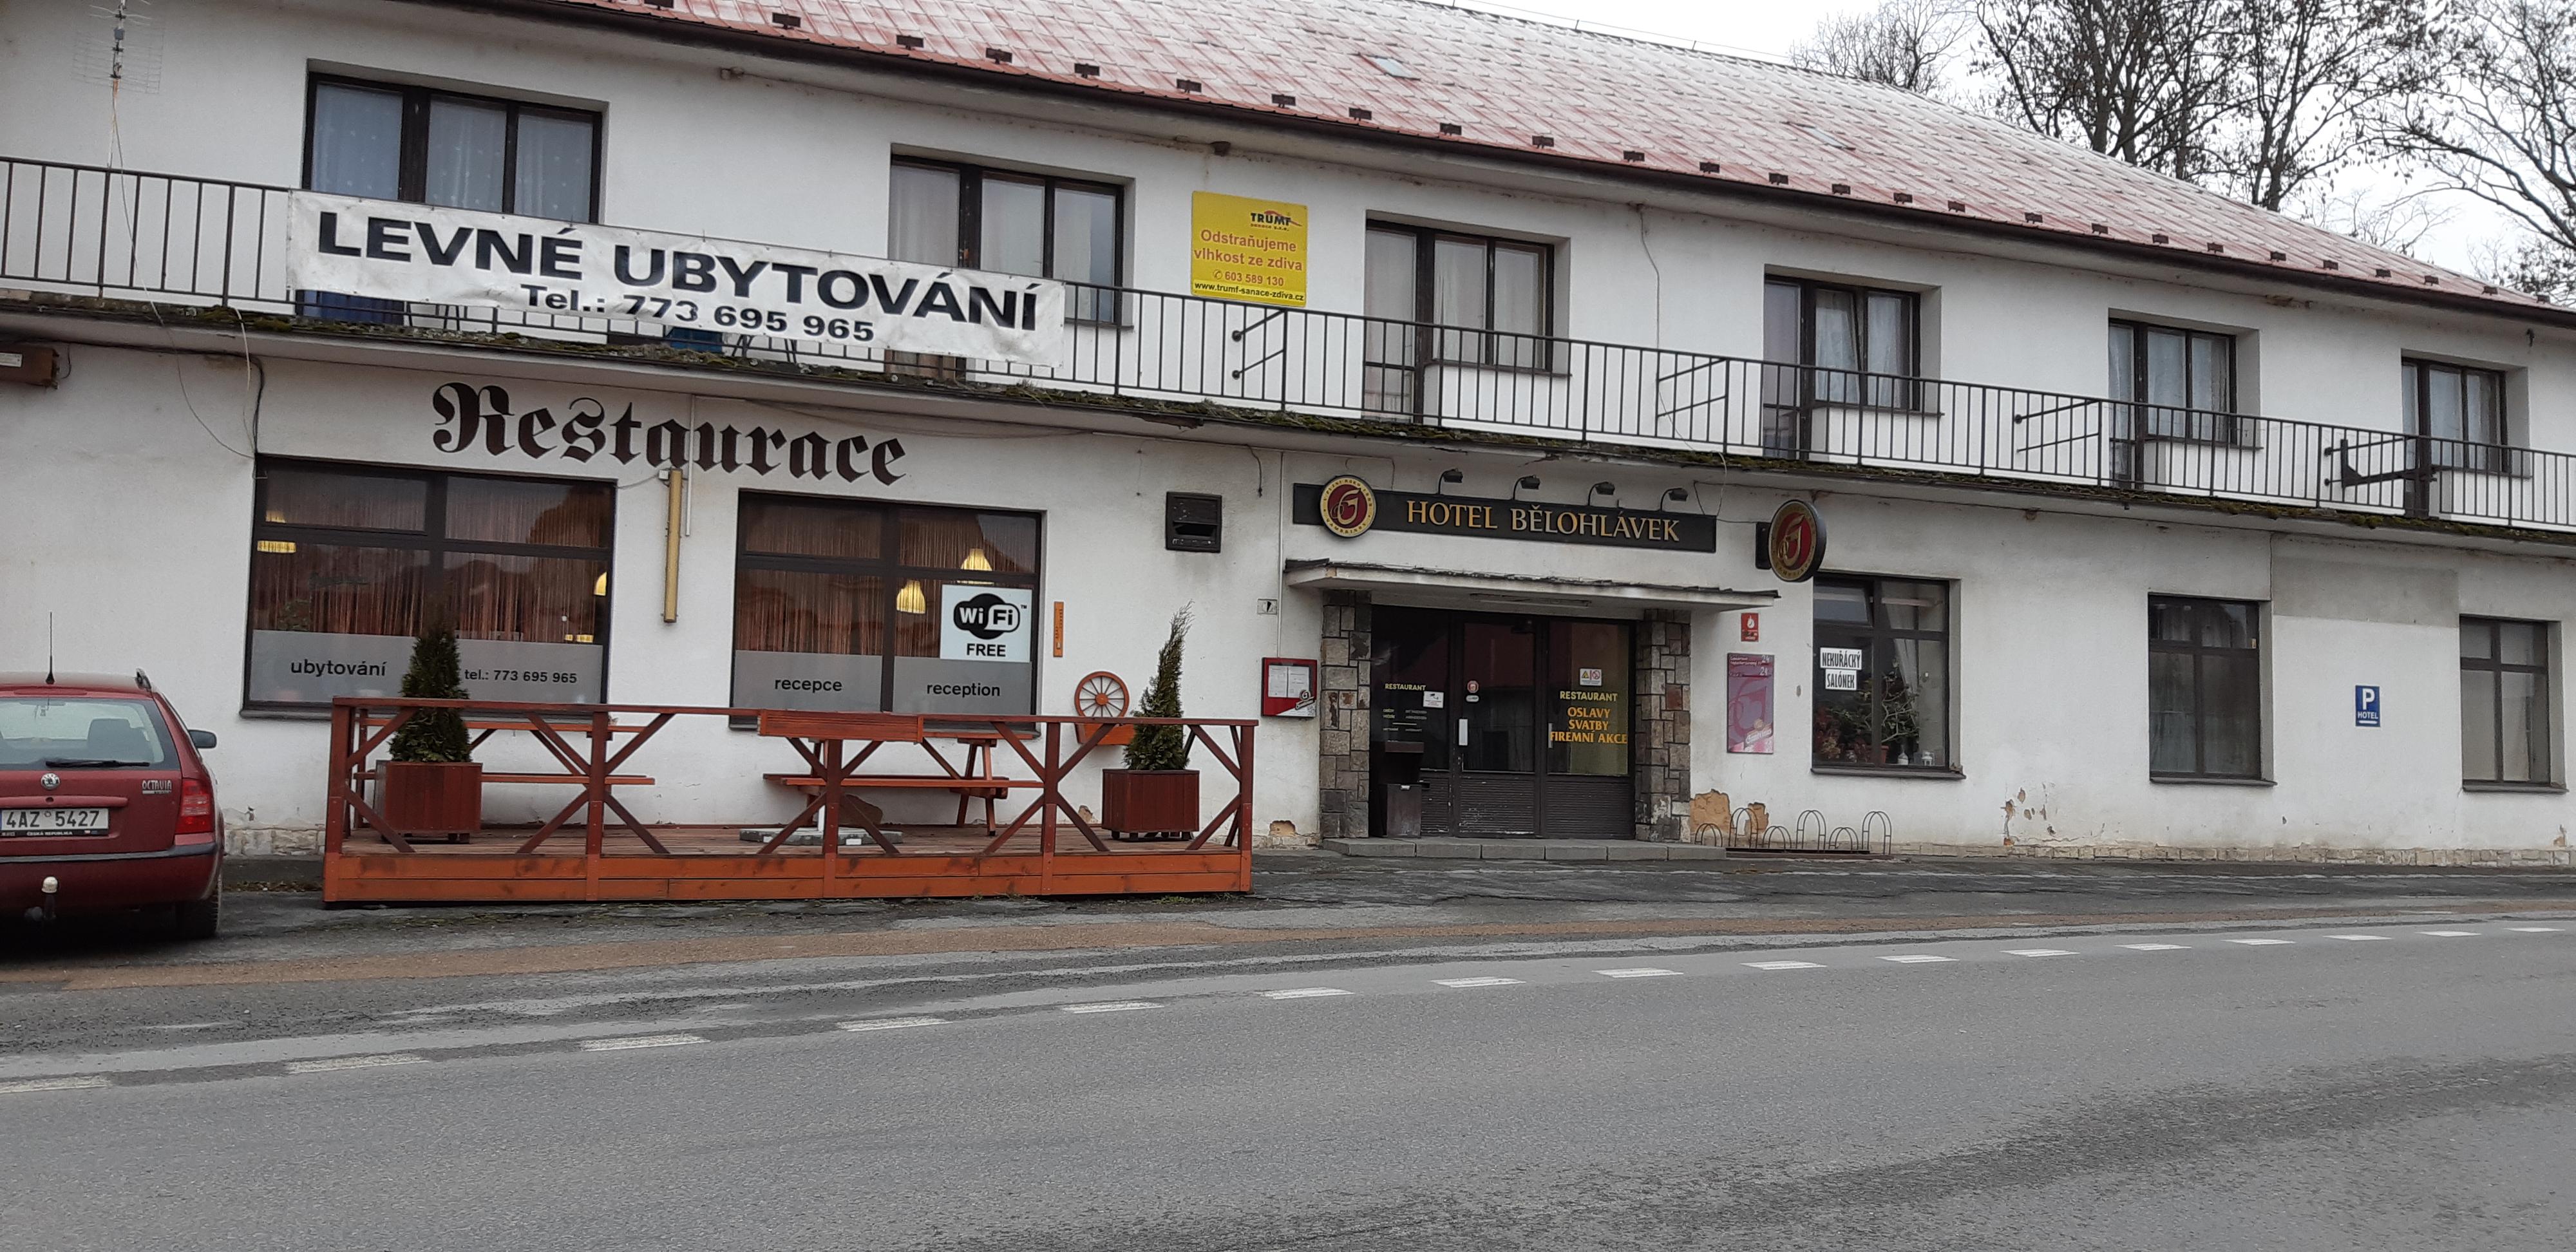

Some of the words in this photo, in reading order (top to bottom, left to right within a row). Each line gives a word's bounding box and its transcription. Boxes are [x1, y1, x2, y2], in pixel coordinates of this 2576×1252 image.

[1251, 213, 1291, 226] TRUMF
[1200, 229, 1296, 252] Odstraňujeme
[1195, 248, 1245, 264] vlhkost
[1248, 256, 1263, 266] ze
[1267, 257, 1303, 271] zdiva
[319, 211, 583, 280] LEVNÉ
[614, 245, 1042, 332] UBYTOVÁNÍ
[1225, 271, 1242, 282] 603
[1245, 274, 1263, 285] 589
[1267, 276, 1283, 287] 130
[1195, 283, 1304, 301] www.trumf-sanace-zdiva.cz
[520, 283, 605, 313] Tel.:
[622, 294, 698, 321] 773
[714, 306, 788, 332] 695
[803, 316, 874, 342] 965
[432, 382, 907, 486] Restaurace
[1406, 500, 1498, 529] HOTEL
[1510, 504, 1680, 542] BĚLOHLÁVEK
[967, 643, 1006, 657] FREE
[290, 658, 386, 678] ubytování
[464, 668, 489, 681] tel.:
[493, 669, 518, 681] 773
[523, 671, 548, 683] 695
[553, 672, 578, 684] 965
[774, 678, 842, 695] recepce
[1827, 670, 1855, 688] SALÓNEK
[927, 683, 1001, 698] reception
[1560, 690, 1618, 702] RESTAURANT
[2362, 688, 2375, 710] P
[1567, 707, 1611, 718] OSLAVY
[2358, 711, 2379, 719] HOTEL
[1568, 719, 1609, 730] SVATBY
[1550, 730, 1595, 743] FIREMNÍ
[1598, 733, 1628, 744] AKCE
[142, 779, 172, 790] OCTAVIA
[6, 811, 40, 828] 4AZ
[55, 810, 100, 827] 5427
